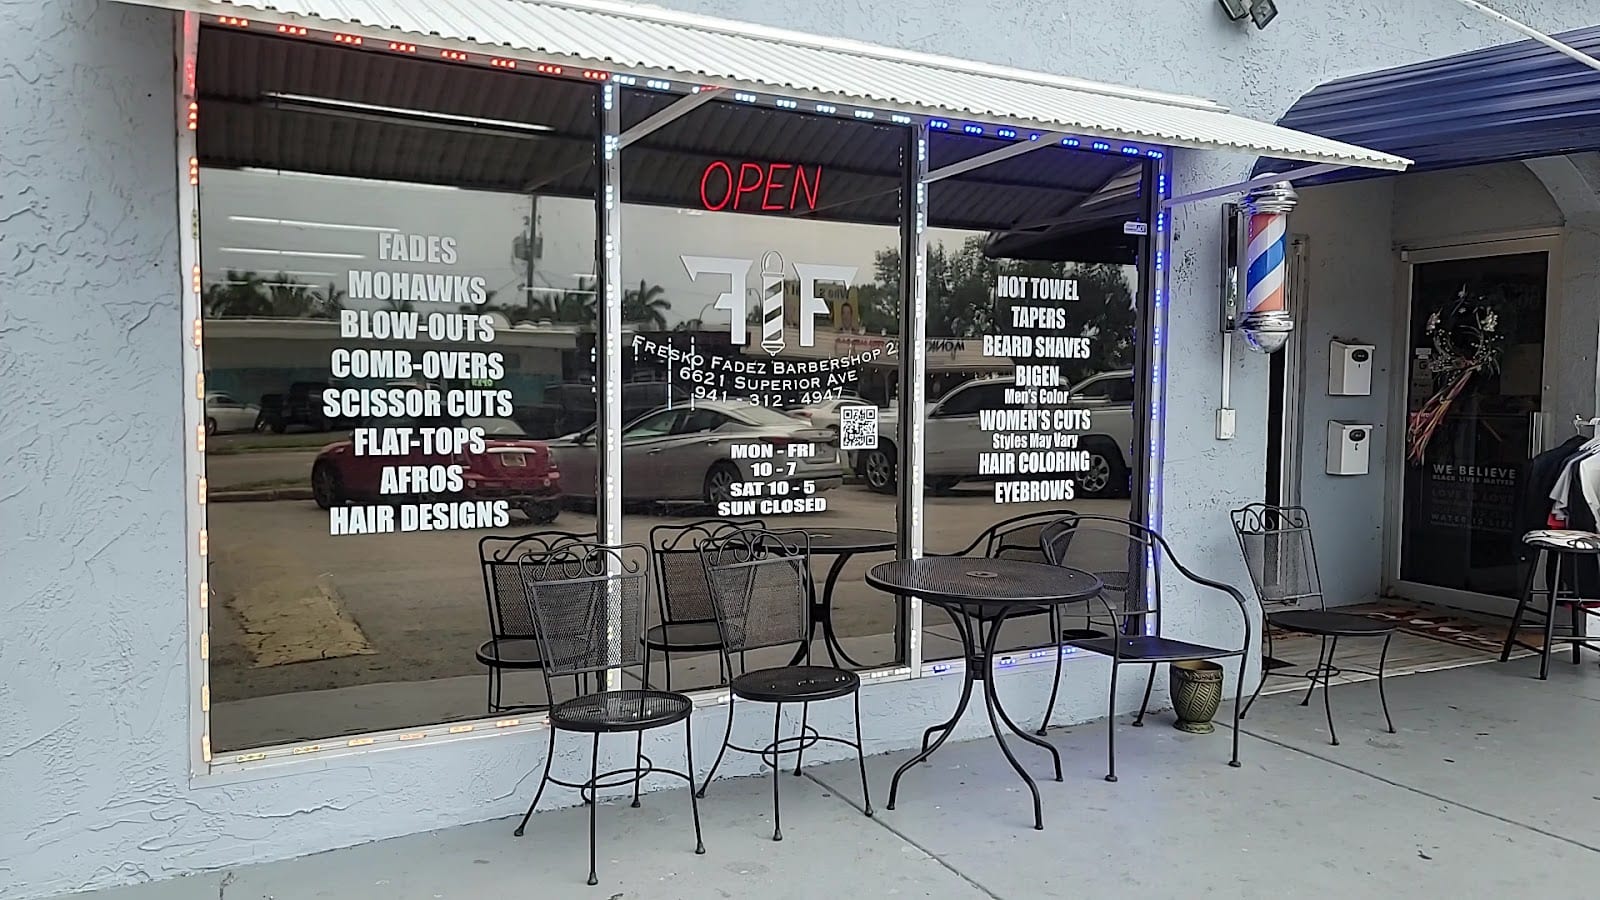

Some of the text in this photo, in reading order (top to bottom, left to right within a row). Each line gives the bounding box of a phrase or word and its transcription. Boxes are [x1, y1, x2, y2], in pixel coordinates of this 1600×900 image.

[700, 160, 823, 211] OPEN
[379, 233, 457, 264] FADES
[349, 270, 486, 304] MOHAWKS
[998, 275, 1079, 300] HOT TOWEL
[341, 310, 495, 342] BLOW-OUTS
[1011, 306, 1066, 329] TAPERS
[632, 335, 704, 367] FRESKO
[711, 356, 766, 374] FADEZ
[774, 349, 881, 374] BARBERSHOP
[983, 335, 1090, 358] BEARD SHAVES
[331, 349, 504, 380] COMB-OVERS
[1015, 365, 1060, 387] BIGEN
[680, 369, 858, 391] 6621 SUPERIOR AVE
[323, 388, 513, 418] SCISSOR CUTS
[695, 387, 727, 402] 941
[750, 393, 783, 407] 312
[801, 387, 843, 404] 4947
[1005, 388, 1068, 404] Men's Color
[980, 410, 1090, 431] WOMEN'S CUTS
[354, 426, 485, 456] FLAT-TOPS
[731, 444, 773, 459] MON
[788, 443, 815, 457] FRI
[993, 432, 1078, 450] Styles May Vary
[751, 462, 773, 477] 10
[786, 462, 797, 476] 7
[979, 451, 1090, 475] HAIR COLORING
[1432, 464, 1518, 479] WE BELIEVE
[380, 465, 463, 494] AFROS
[730, 482, 766, 497] SAT
[767, 481, 788, 496] 10
[803, 480, 815, 494] 5
[995, 480, 1074, 503] EYEBROWS
[330, 500, 509, 535] HAIR DESIGNS
[718, 497, 827, 516] SUN CLOSED
